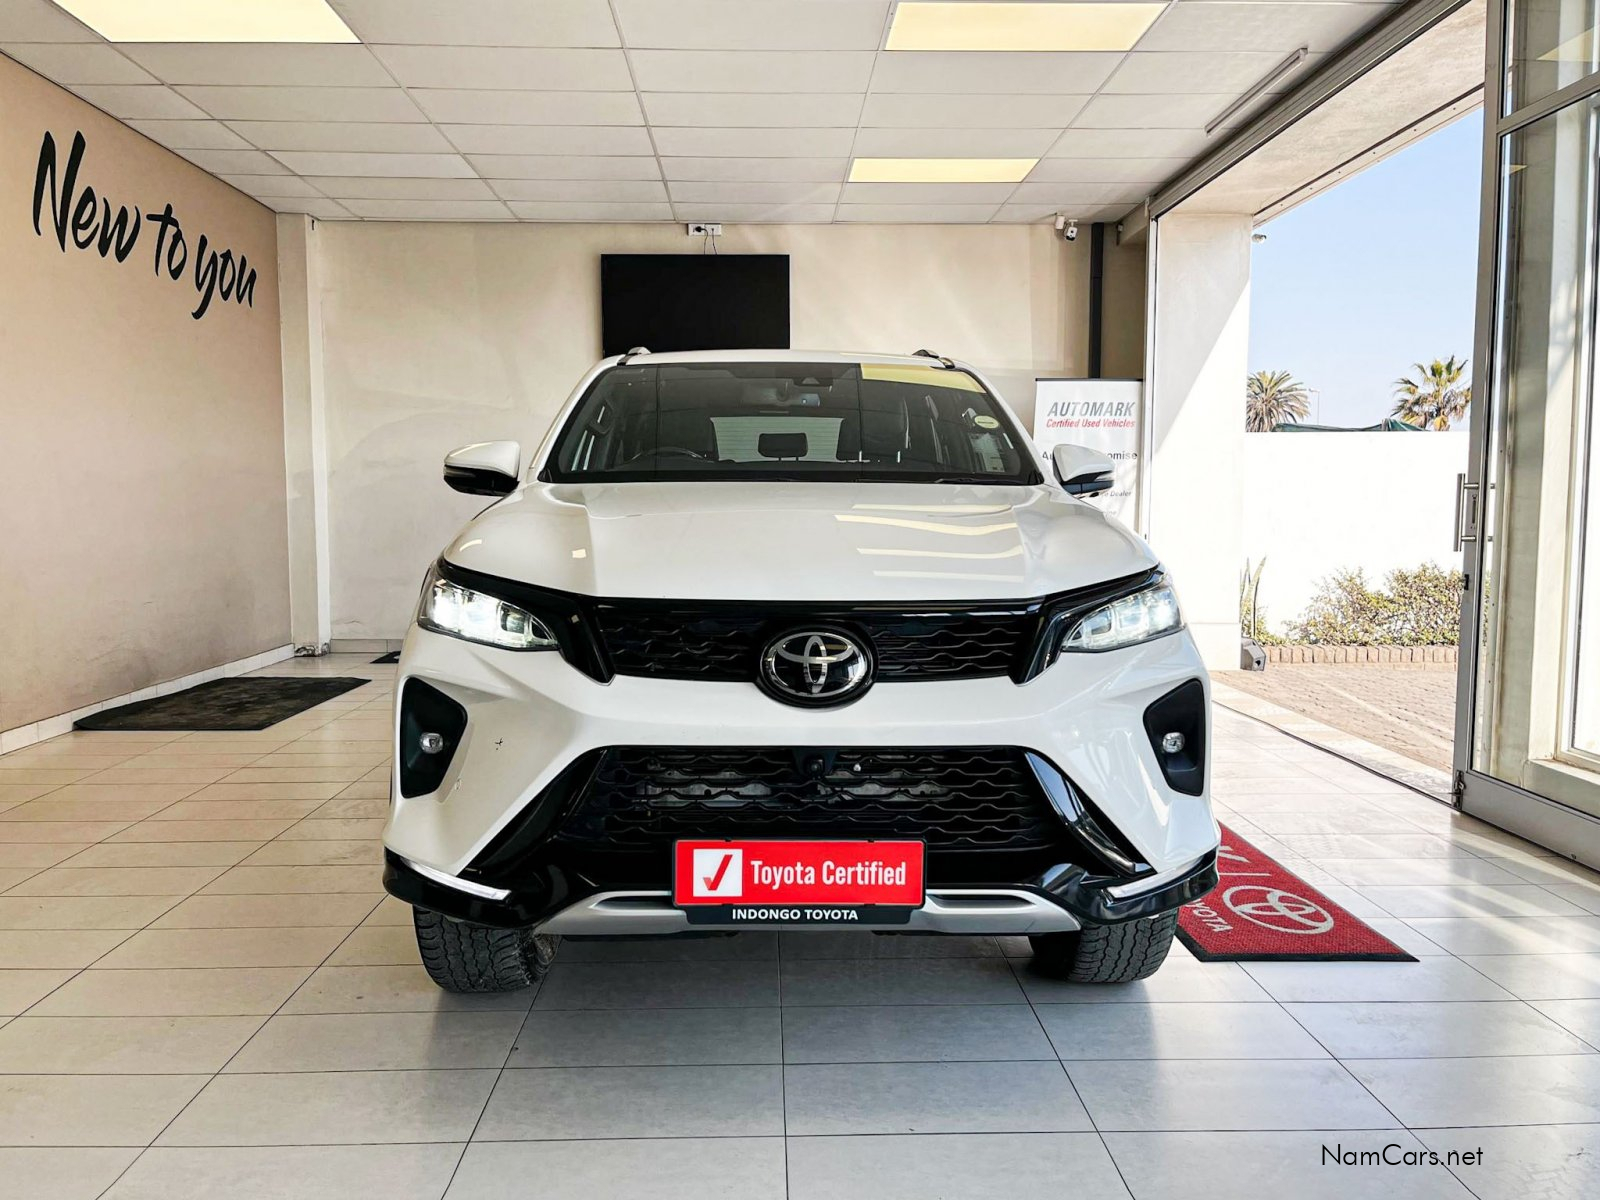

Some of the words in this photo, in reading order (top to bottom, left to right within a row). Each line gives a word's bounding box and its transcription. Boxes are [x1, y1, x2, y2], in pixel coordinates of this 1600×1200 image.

[33, 130, 141, 263] New
[146, 203, 188, 281] to
[191, 234, 257, 320] you
[1047, 401, 1136, 417] AUTOMARK
[1046, 418, 1080, 428] Certified
[1082, 418, 1101, 428] Used
[1102, 418, 1136, 428] Vehicles
[1107, 450, 1138, 460] omise
[751, 860, 815, 890] Toyota
[821, 860, 907, 886] Certified
[732, 909, 801, 920] INDONGO
[806, 909, 859, 921] TOYOTA
[1183, 898, 1234, 932] YOTA
